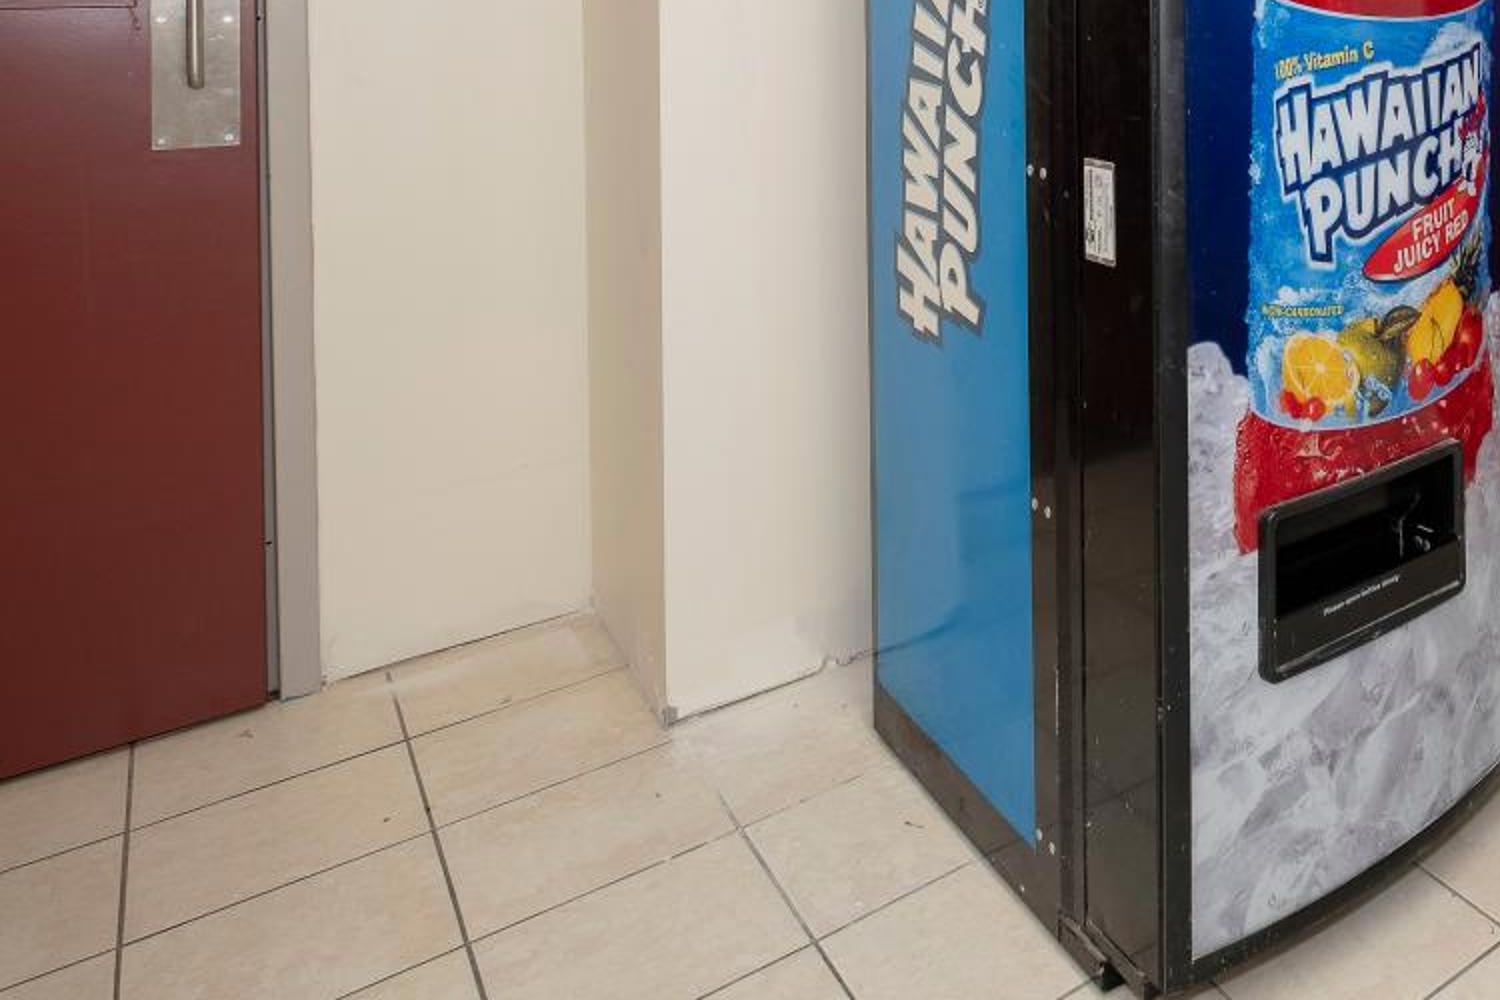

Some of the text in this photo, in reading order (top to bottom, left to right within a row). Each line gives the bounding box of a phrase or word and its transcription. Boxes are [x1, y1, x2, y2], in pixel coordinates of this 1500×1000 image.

[1276, 40, 1375, 80] 100% Vitamin C
[1278, 48, 1480, 187] HAWAIIAN
[1303, 118, 1464, 256] PUNCH
[1411, 197, 1455, 241] FRUIT
[1393, 208, 1469, 274] JUICY RED
